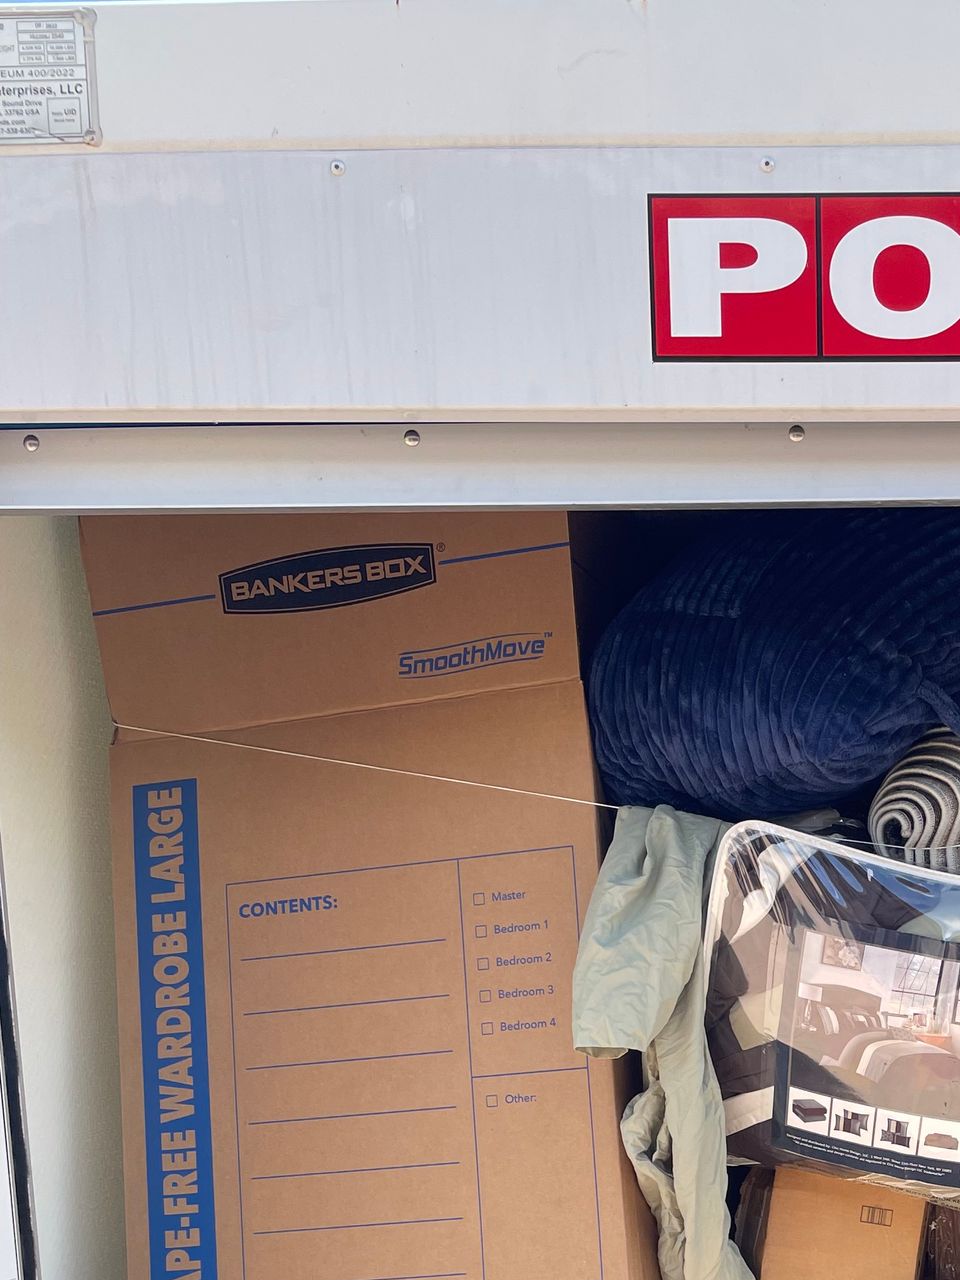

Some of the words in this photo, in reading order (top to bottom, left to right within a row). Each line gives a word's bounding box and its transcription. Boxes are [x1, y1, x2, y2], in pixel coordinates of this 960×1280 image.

[27, 68, 75, 77] 400/2022
[0, 84, 56, 98] terprises,
[60, 83, 83, 94] LLC
[231, 564, 362, 602] BANKERS
[366, 555, 427, 582] BOX
[399, 636, 545, 676] SmoothMove
[149, 786, 185, 904] LARGE
[491, 889, 526, 903] Master
[239, 895, 338, 919] CONTENTS:
[494, 921, 540, 935] Bedroom
[544, 920, 549, 930] 1
[496, 953, 542, 967] Bedroom
[545, 952, 552, 963] 2
[498, 986, 545, 1000] Bedroom
[547, 984, 555, 995] 3
[151, 913, 195, 1124] WARDROBE
[500, 1019, 547, 1032] Bedroom
[549, 1017, 556, 1028] 4
[505, 1092, 537, 1105] Other:
